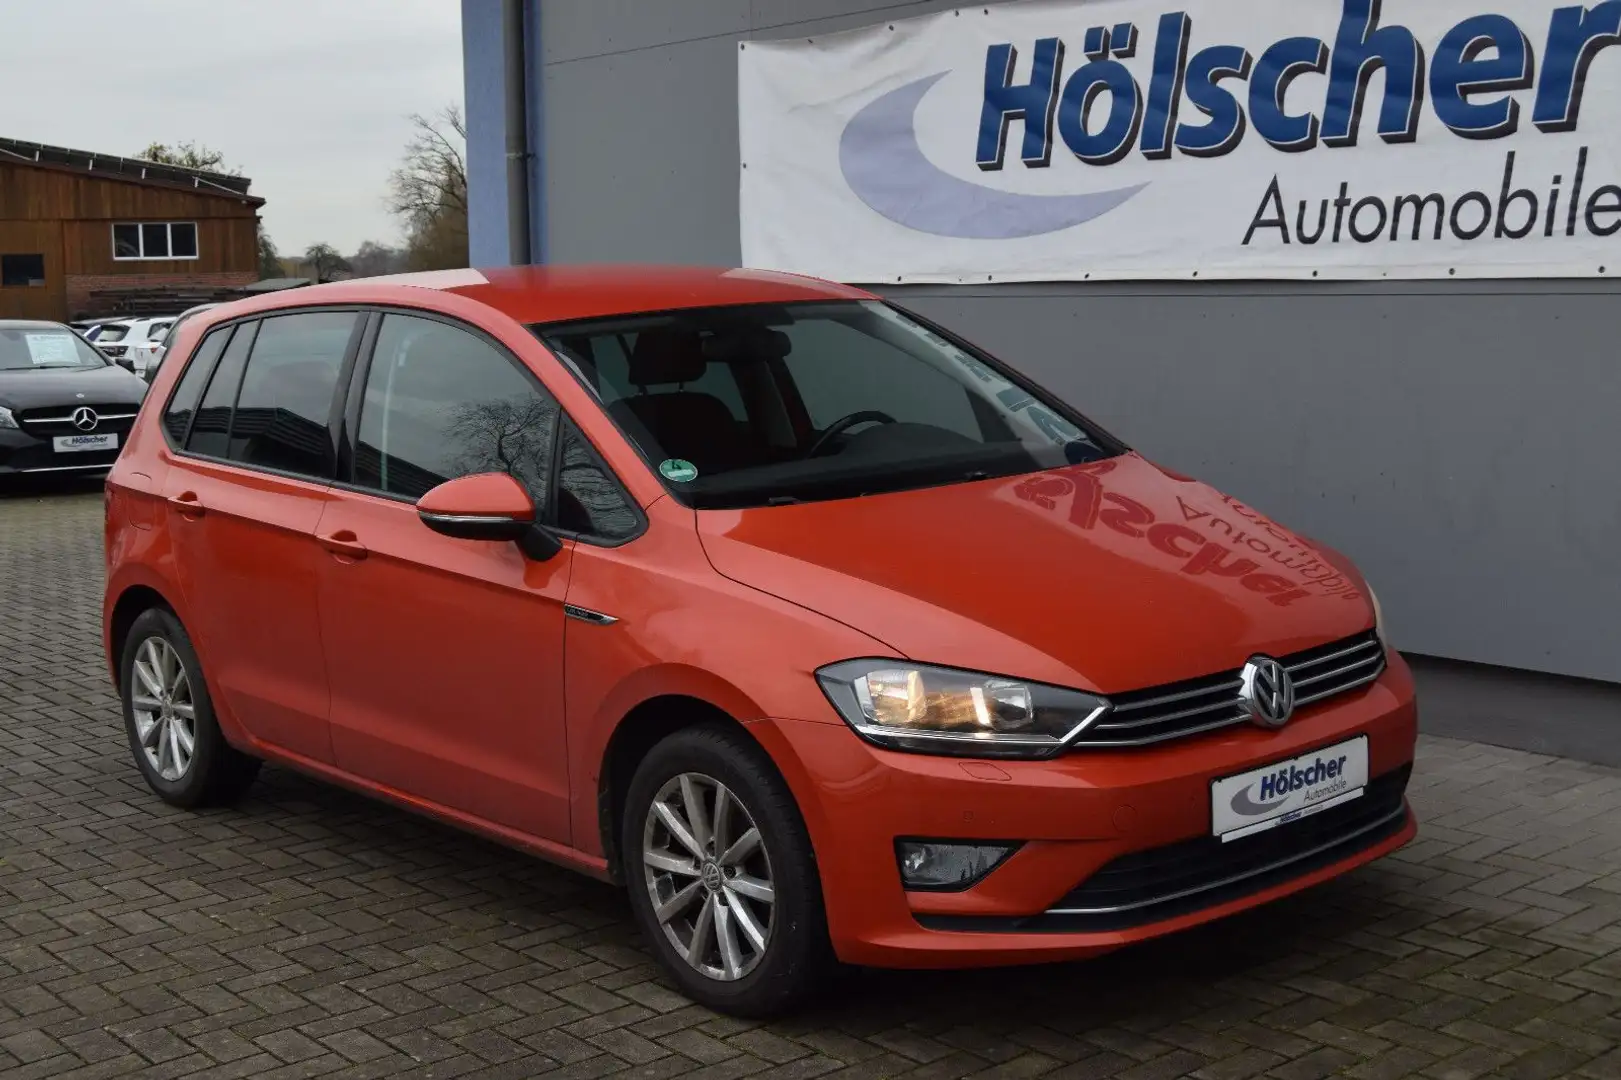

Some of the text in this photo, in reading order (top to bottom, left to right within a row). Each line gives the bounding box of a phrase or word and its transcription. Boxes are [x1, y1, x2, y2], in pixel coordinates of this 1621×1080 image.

[975, 0, 1621, 171] Hölscher
[1241, 147, 1621, 247] Automobile
[1260, 755, 1347, 801] Hölscher
[1304, 779, 1347, 801] Automobile
